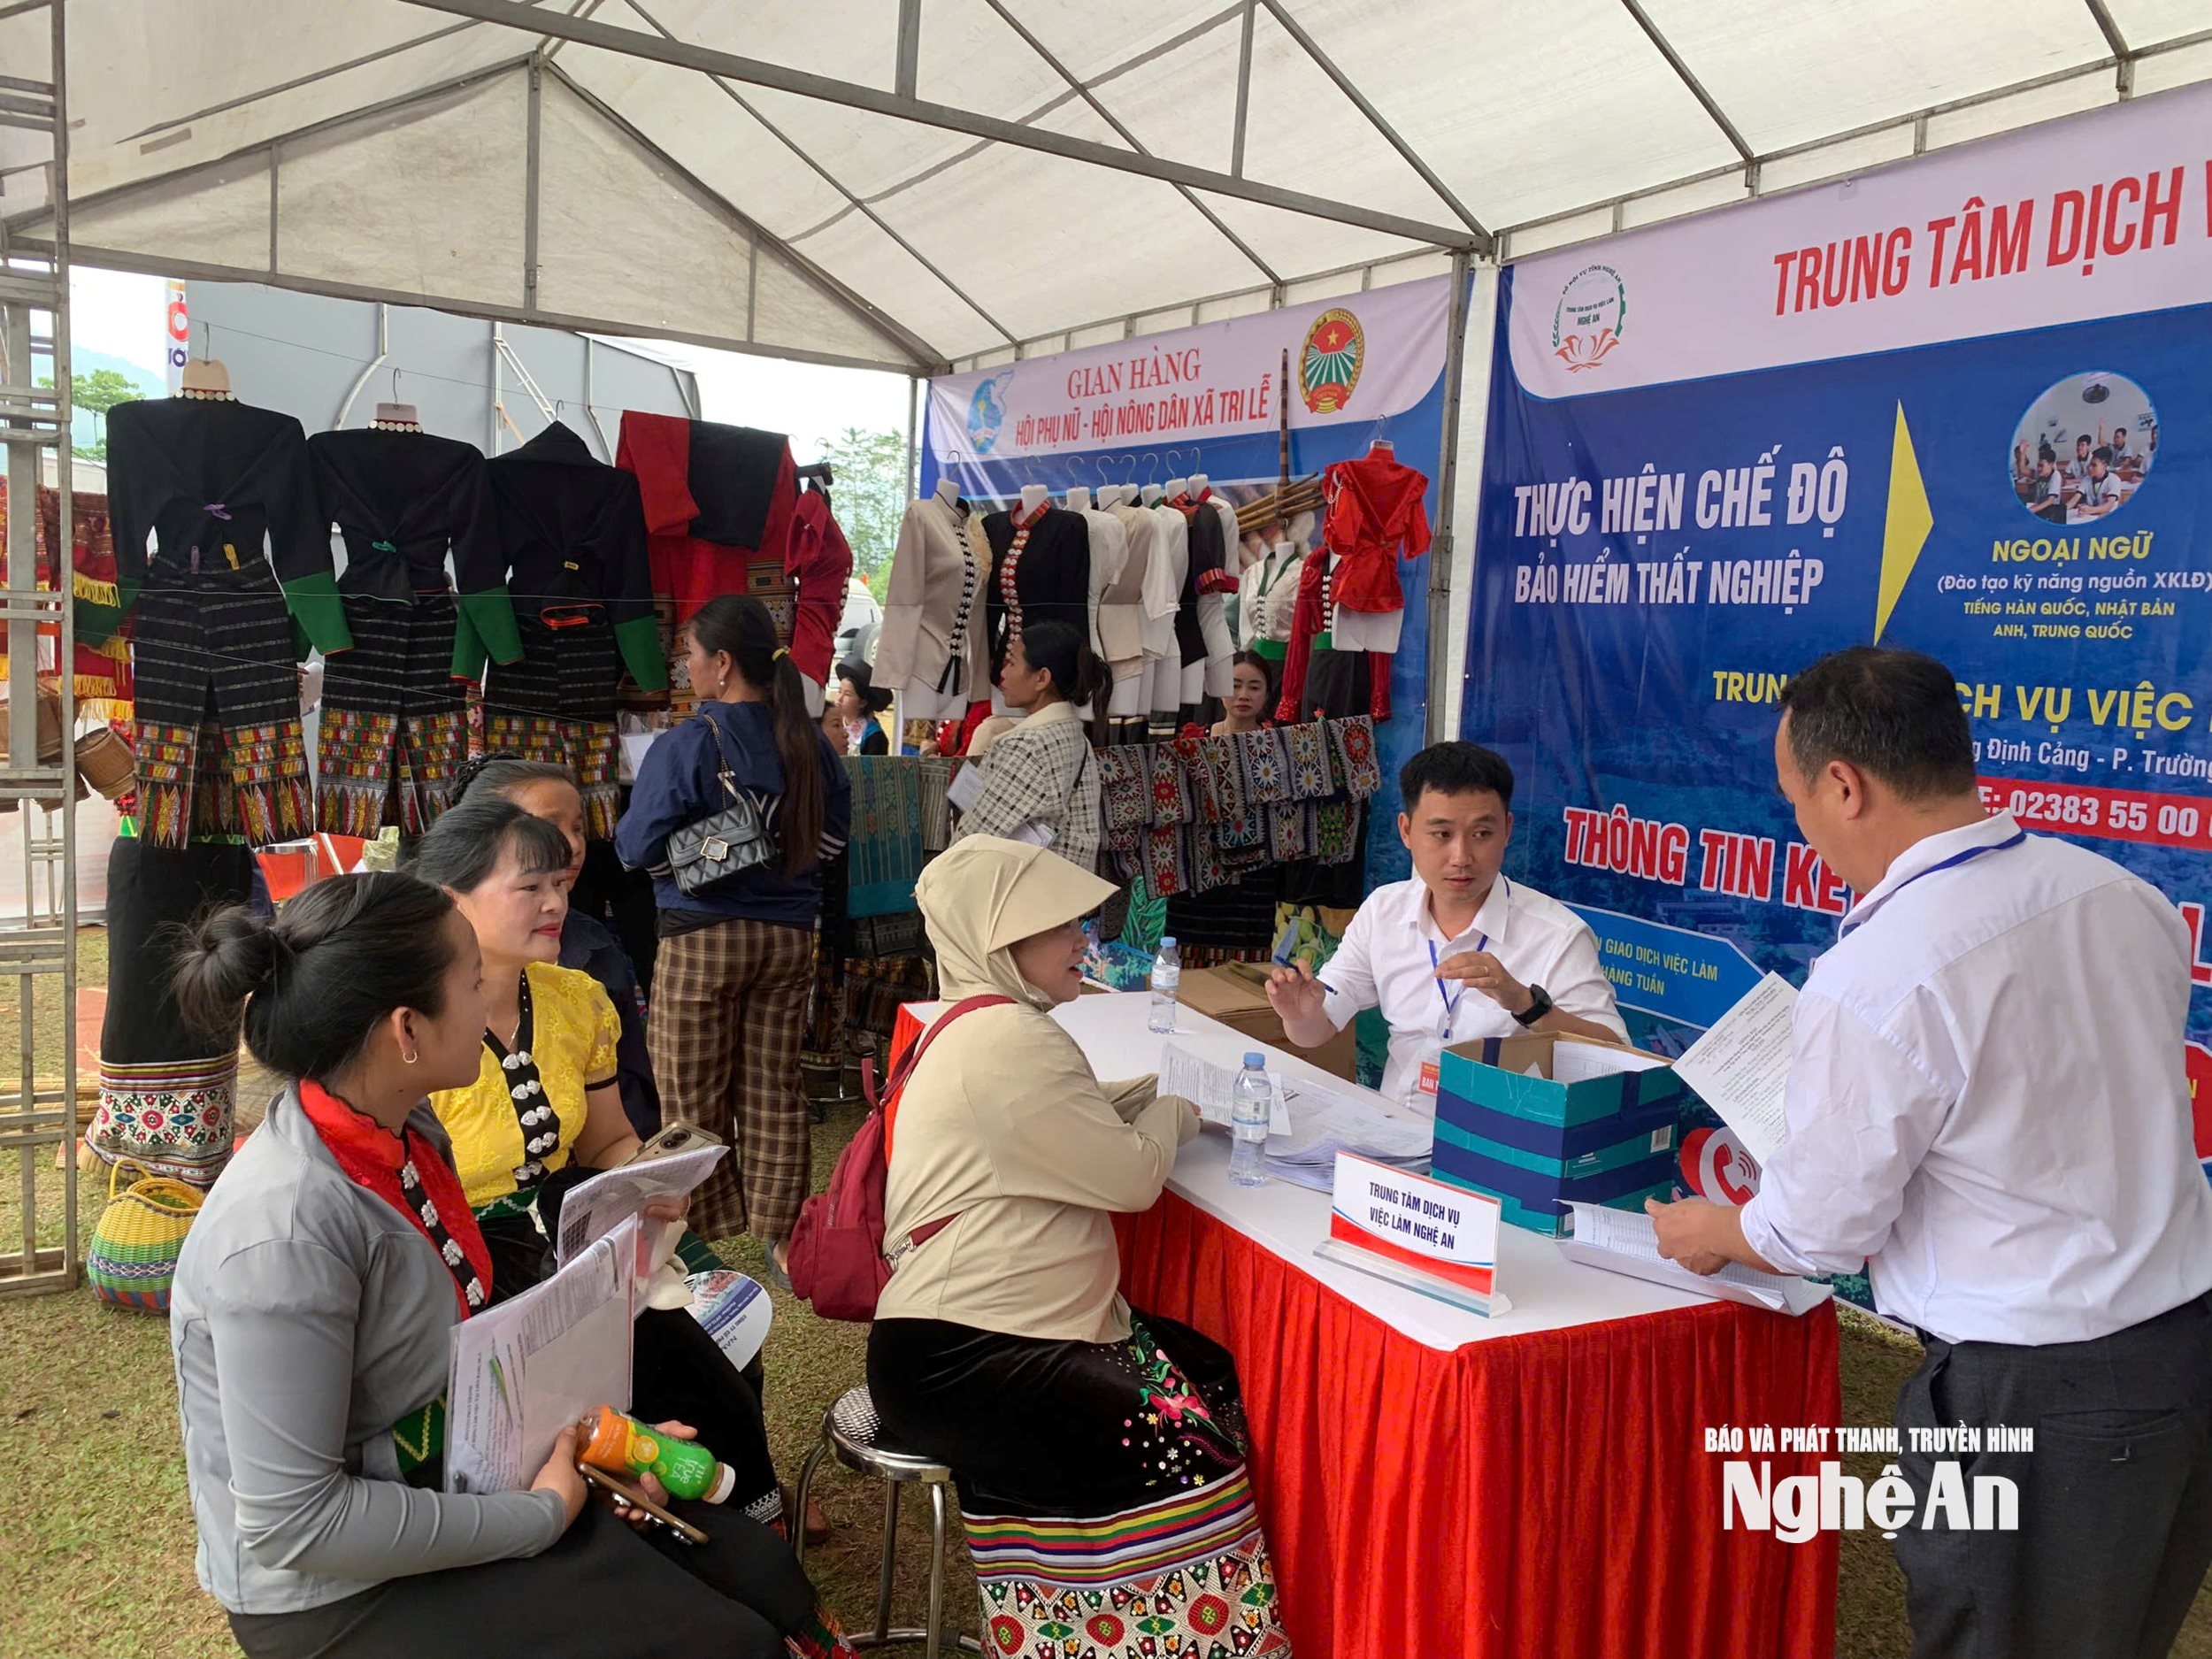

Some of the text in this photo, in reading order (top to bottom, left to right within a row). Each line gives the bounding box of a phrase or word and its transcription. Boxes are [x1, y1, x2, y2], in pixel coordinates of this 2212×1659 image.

[1774, 227, 1912, 316] TRUNG
[1927, 196, 2034, 288] TÂM
[2047, 165, 2185, 277] DỊCH
[1068, 345, 1202, 401] GIAN HÀNG
[1016, 414, 1034, 450] HỘI
[1037, 412, 1061, 449] PHỤ
[1063, 407, 1081, 442] NỮ
[1092, 403, 1112, 443] HỘI
[1117, 399, 1154, 435] NÔNG
[1157, 393, 1189, 431] DÂN
[1192, 388, 1214, 426] XÃ
[1219, 389, 1243, 424] TRI
[1248, 373, 1271, 420] LỄ
[1514, 444, 1848, 548] THỰC HIỆN CHẾ ĐỘ
[1992, 530, 2154, 567] NGOẠI NGỮ
[1515, 546, 1824, 615] BẢO HIỂM THẤT NGHIỆP
[1937, 575, 1977, 593] (Đào
[1982, 576, 2008, 594] tạo
[2014, 573, 2033, 593] kỹ
[2037, 572, 2083, 593] năng
[2087, 568, 2147, 593] nguồn
[1963, 596, 2176, 618] TIẾNG HÀN QUỐC, NHẬT BẢN
[1993, 620, 2133, 640] ANH, TRUNG QUỐC
[1713, 671, 1788, 703] TRUN
[1955, 681, 2001, 719] CH
[2016, 686, 2071, 733] VỤ
[2087, 680, 2193, 740] VIỆC
[1987, 738, 2032, 764] Định
[2038, 741, 2089, 772] Cảng
[2113, 748, 2132, 771] P.
[2009, 790, 2100, 826] 02383
[2108, 800, 2147, 832] 55
[2157, 805, 2199, 837] 00
[1564, 803, 1689, 886] THÔNG
[1700, 828, 1776, 902] TIN
[1605, 939, 1633, 959] GIAO
[1636, 945, 1661, 966] DỊCH
[1663, 951, 1689, 976] VIỆC
[1692, 960, 1718, 982] LÀM
[1370, 1182, 1460, 1228] TRUNG TÂM DỊCH VỤ
[1370, 1207, 1455, 1249] VIỆC LÀM NGHỆ AN
[680, 1456, 695, 1484] true
